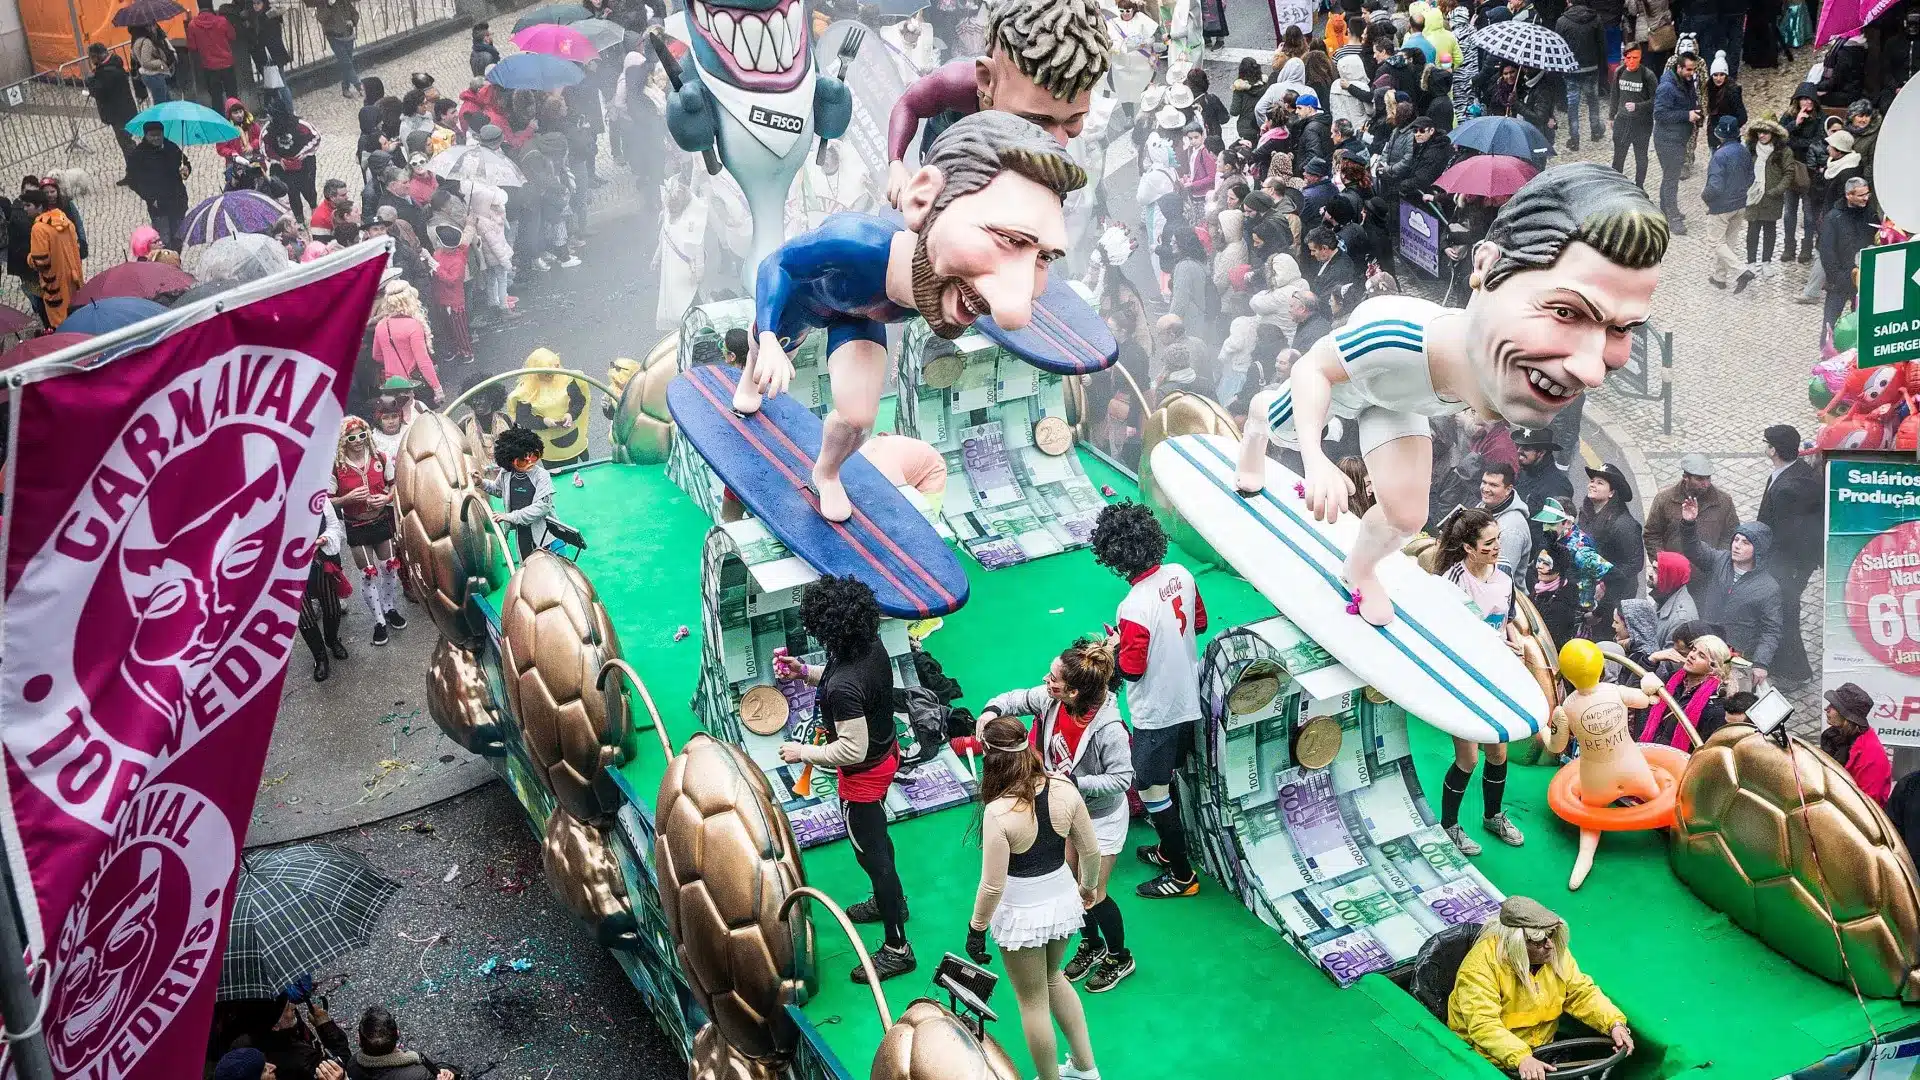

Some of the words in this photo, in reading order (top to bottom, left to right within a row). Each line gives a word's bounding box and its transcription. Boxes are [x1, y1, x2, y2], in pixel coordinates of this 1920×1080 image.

[752, 109, 768, 125] EL
[769, 114, 802, 132] FISCO
[1873, 321, 1909, 337] SAÍDA
[1873, 338, 1920, 357] EMERGE
[54, 353, 332, 563] CARNAVAL
[963, 438, 982, 469] 500
[1848, 469, 1920, 487] Salários
[1171, 594, 1188, 638] 5
[749, 694, 766, 720] 2
[26, 705, 149, 825] TOR
[1357, 766, 1370, 785] 100
[810, 775, 833, 799] 100
[1249, 771, 1259, 790] 100
[1280, 783, 1305, 825] 500
[1410, 811, 1424, 829] 100
[1352, 849, 1367, 866] 500
[1381, 841, 1401, 862] 10
[1420, 841, 1453, 871] 100
[1300, 869, 1315, 885] 100
[1390, 874, 1405, 889] 100
[1332, 898, 1360, 927] 100
[1431, 898, 1464, 925] 500
[1302, 918, 1318, 931] 100
[1323, 951, 1359, 979] 500
[88, 918, 214, 1080] VEDRAS
